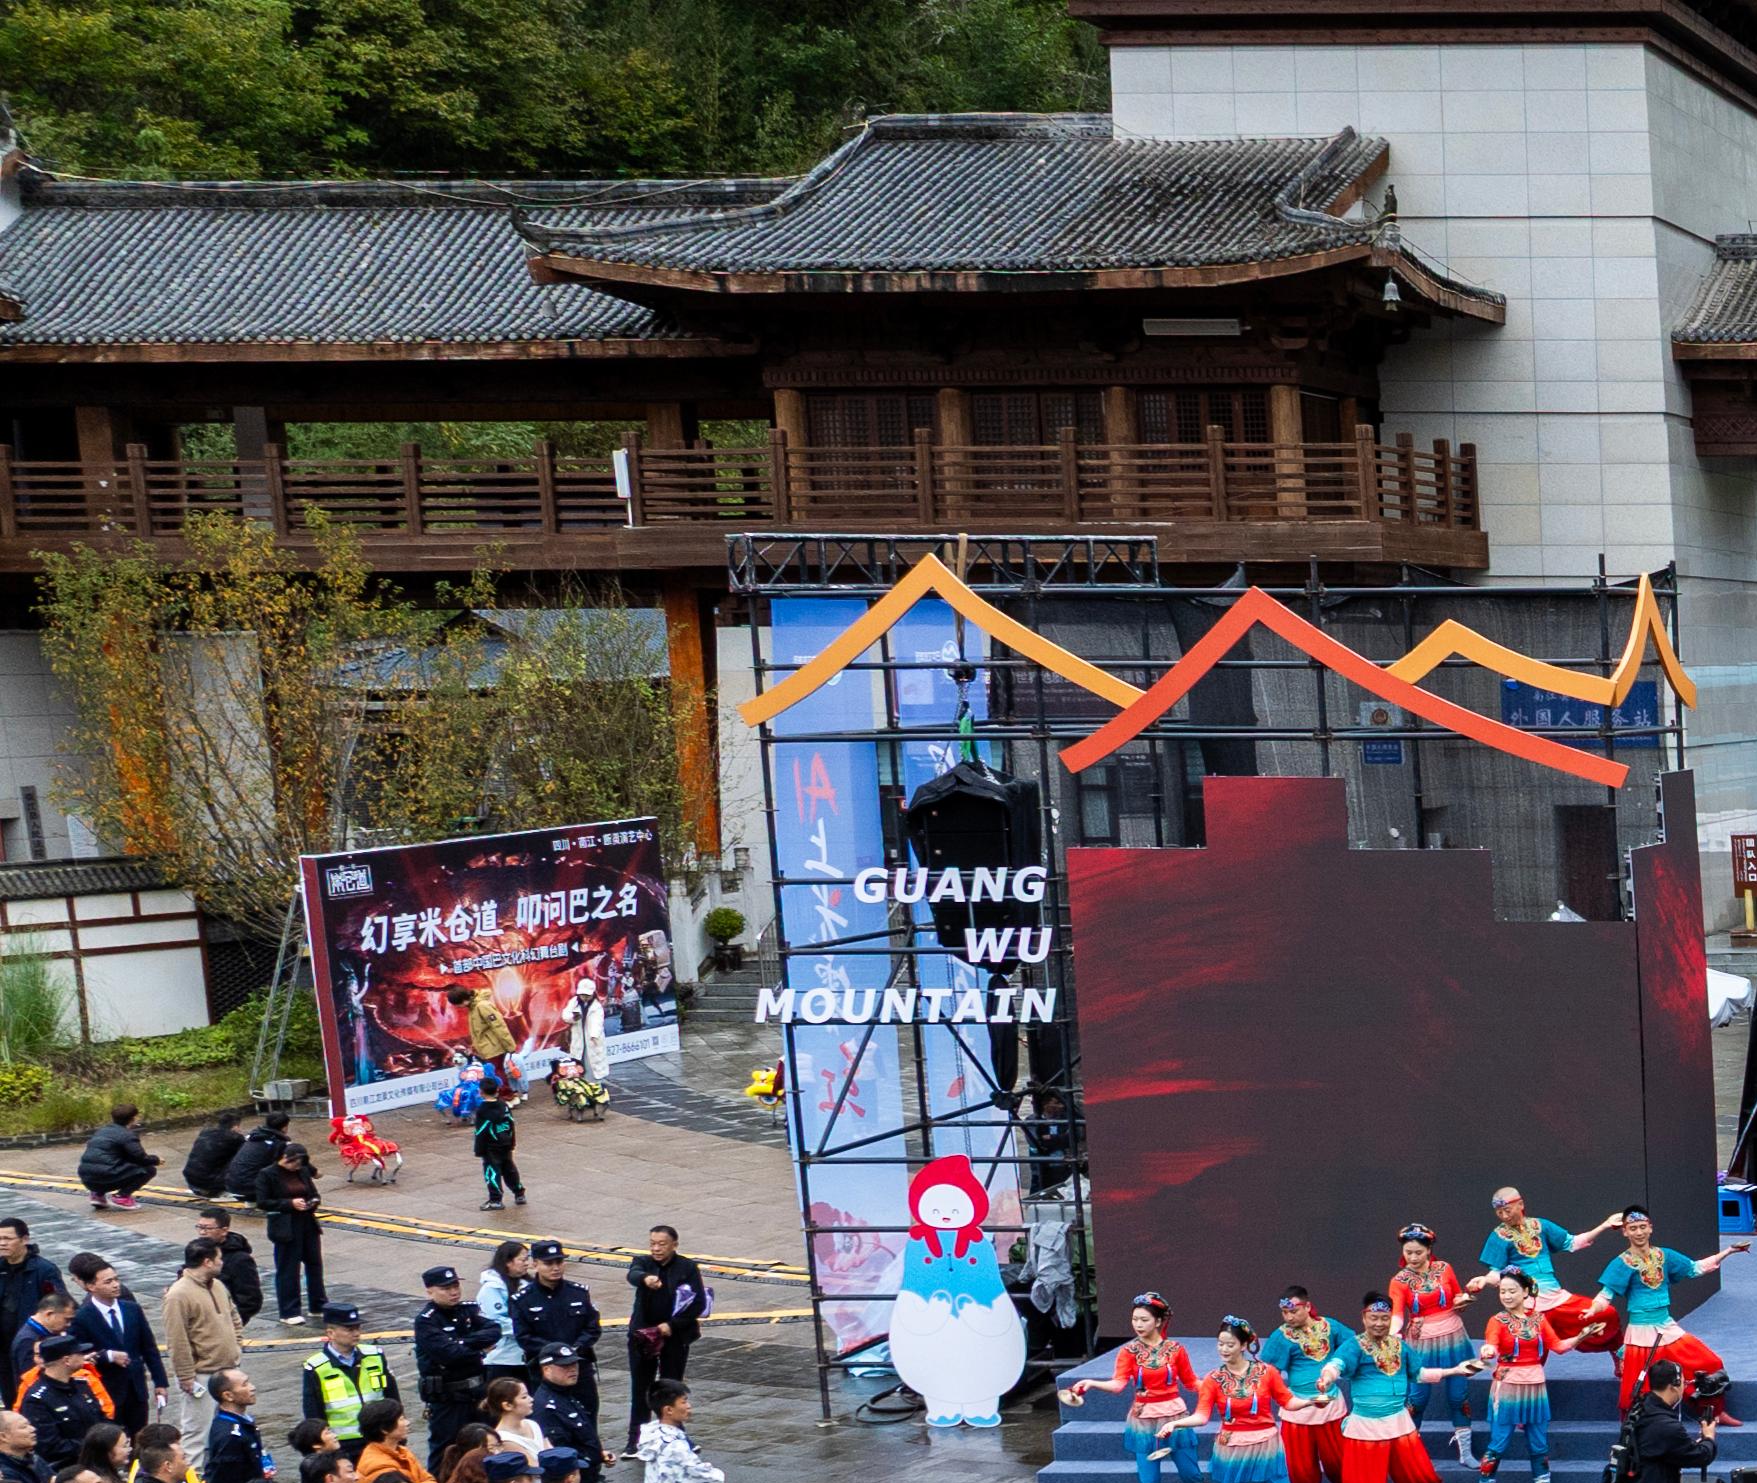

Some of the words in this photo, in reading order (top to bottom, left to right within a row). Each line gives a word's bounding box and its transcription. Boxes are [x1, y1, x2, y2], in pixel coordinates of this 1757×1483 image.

[854, 866, 1047, 903] GUANG
[360, 899, 503, 954] 幻享米仓道
[516, 883, 638, 934] 叩问巴之名
[452, 943, 568, 974] 首部中国巴文化科幻舞台剧
[964, 928, 1052, 963] WU
[754, 988, 1056, 1024] MOUNTAIN
